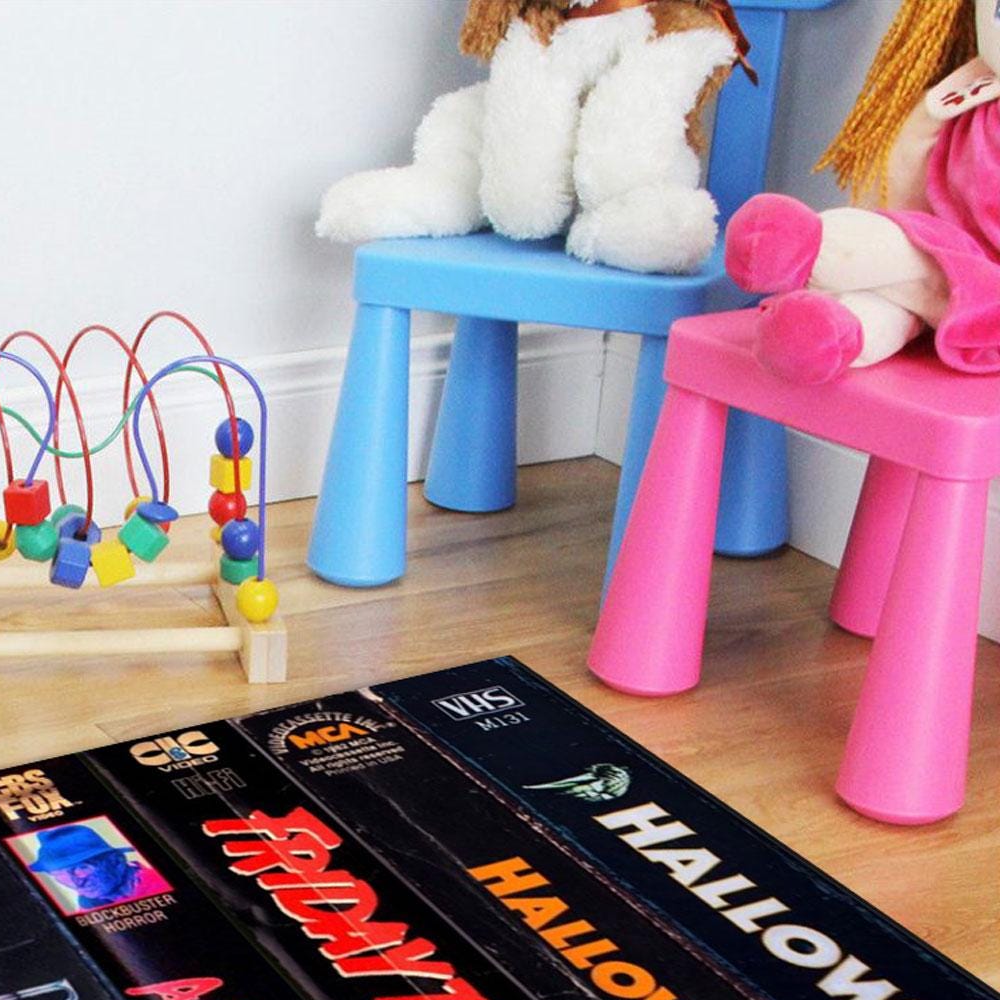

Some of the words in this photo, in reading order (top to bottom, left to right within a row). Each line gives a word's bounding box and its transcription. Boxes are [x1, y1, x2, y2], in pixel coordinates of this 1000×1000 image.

[434, 686, 518, 719] VHS
[474, 711, 531, 732] M131
[287, 722, 371, 750] MCA
[157, 753, 220, 774] VIDEO
[201, 806, 455, 978] FRIDAY
[75, 894, 178, 928] BLOCKBUSTER
[102, 909, 169, 935] HORROR
